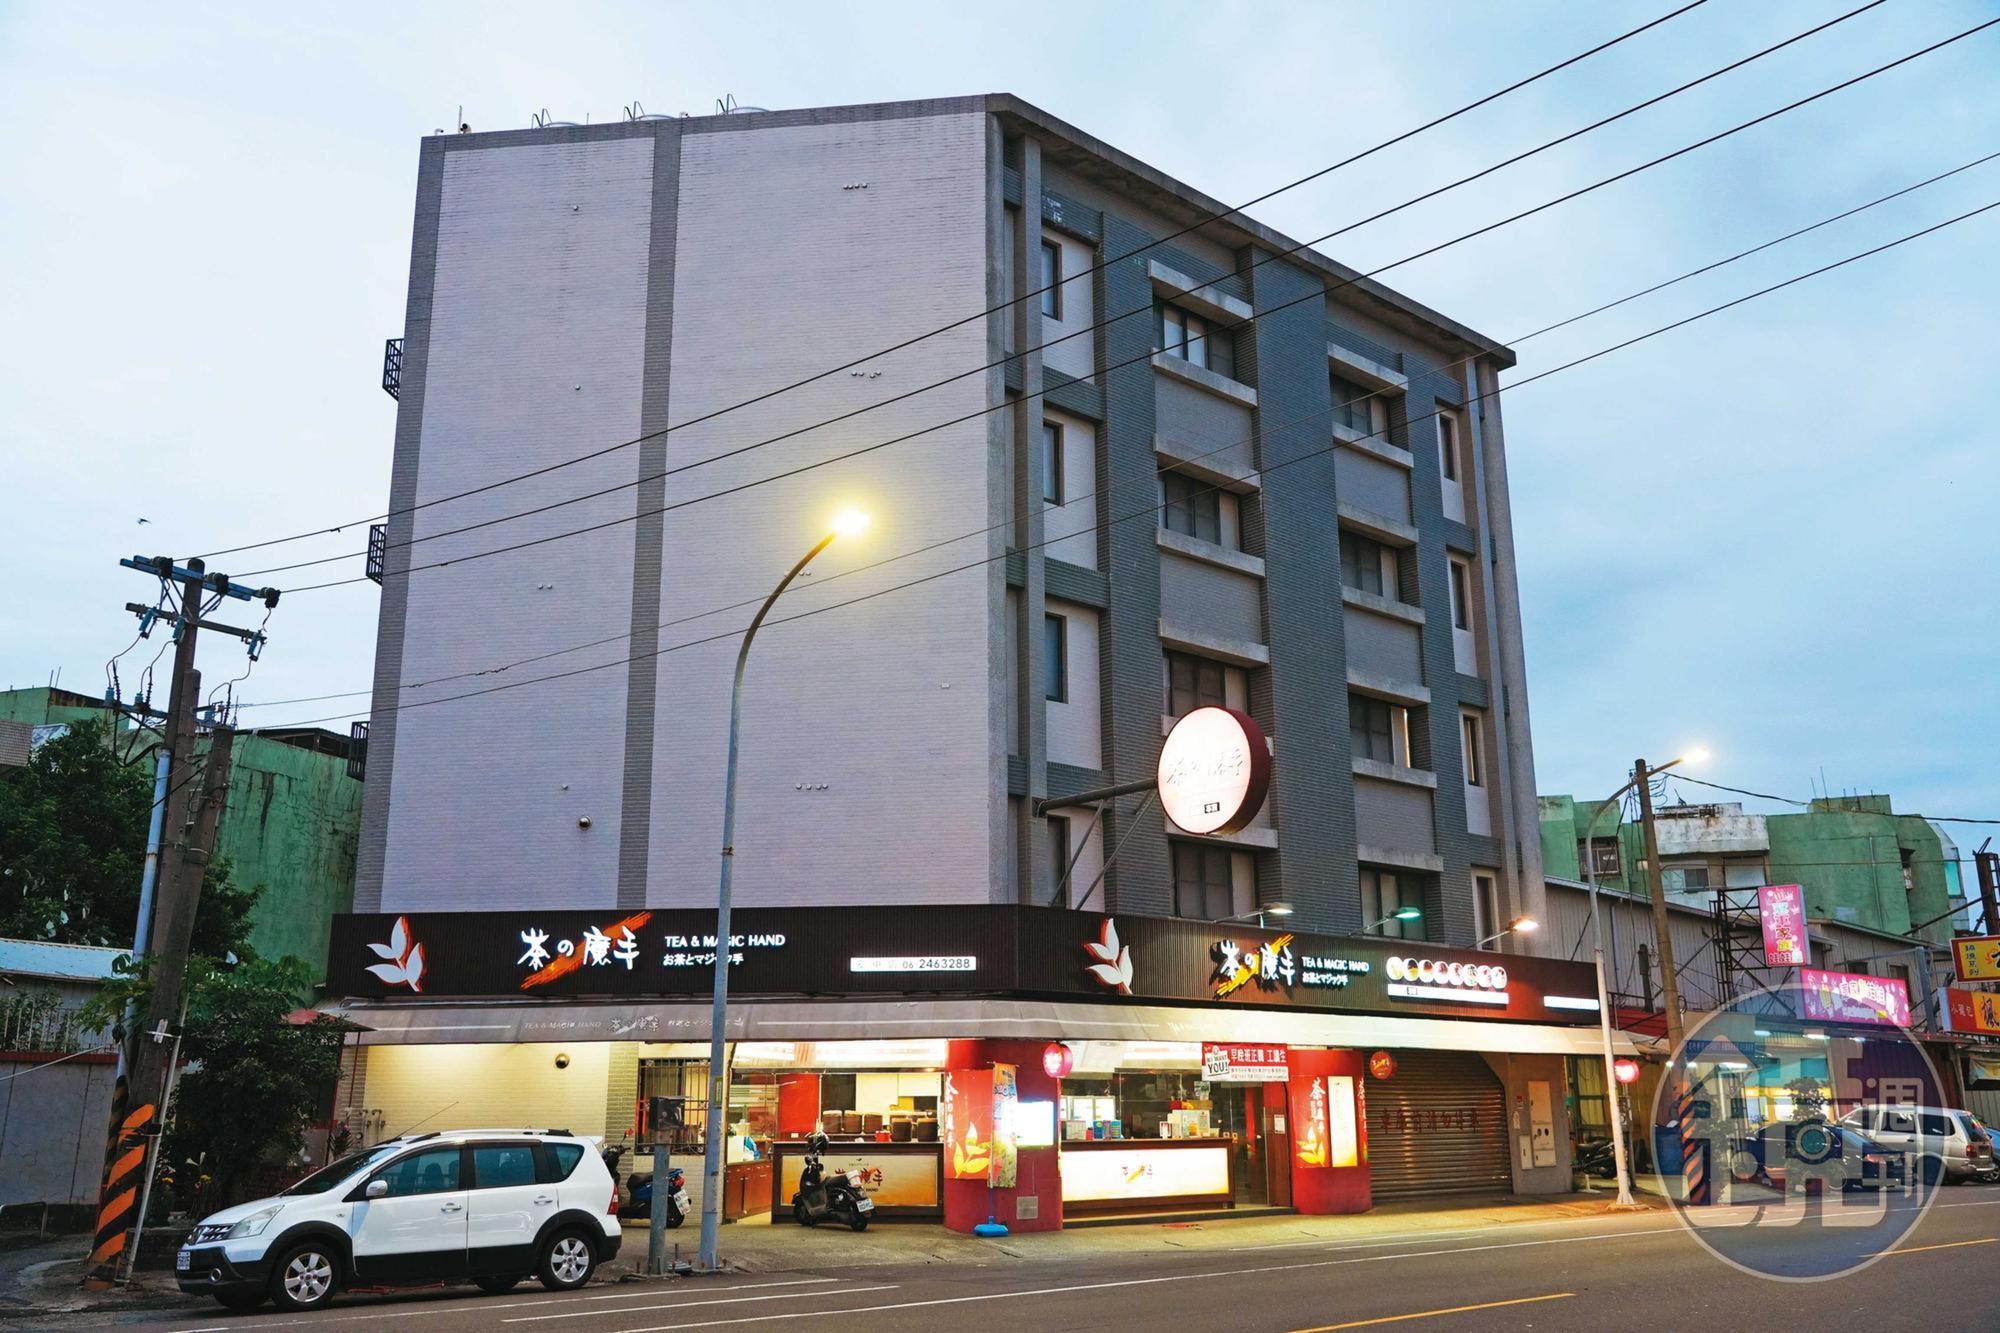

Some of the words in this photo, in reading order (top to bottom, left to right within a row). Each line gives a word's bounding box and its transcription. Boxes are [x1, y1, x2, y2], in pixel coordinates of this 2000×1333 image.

[518, 925, 640, 970] 茶の魔手
[665, 935, 688, 948] TEA
[691, 935, 700, 947] &
[703, 934, 745, 947] MAIC
[748, 934, 786, 947] HAND
[663, 952, 744, 966] お茶とマジク手
[902, 960, 914, 969] 06
[919, 958, 970, 969] 2463288
[1301, 956, 1316, 969] TEA
[1316, 957, 1323, 968] &
[1323, 958, 1348, 970] MAGIC
[1348, 960, 1370, 972] HAND
[1208, 1061, 1228, 1074] YOU!
